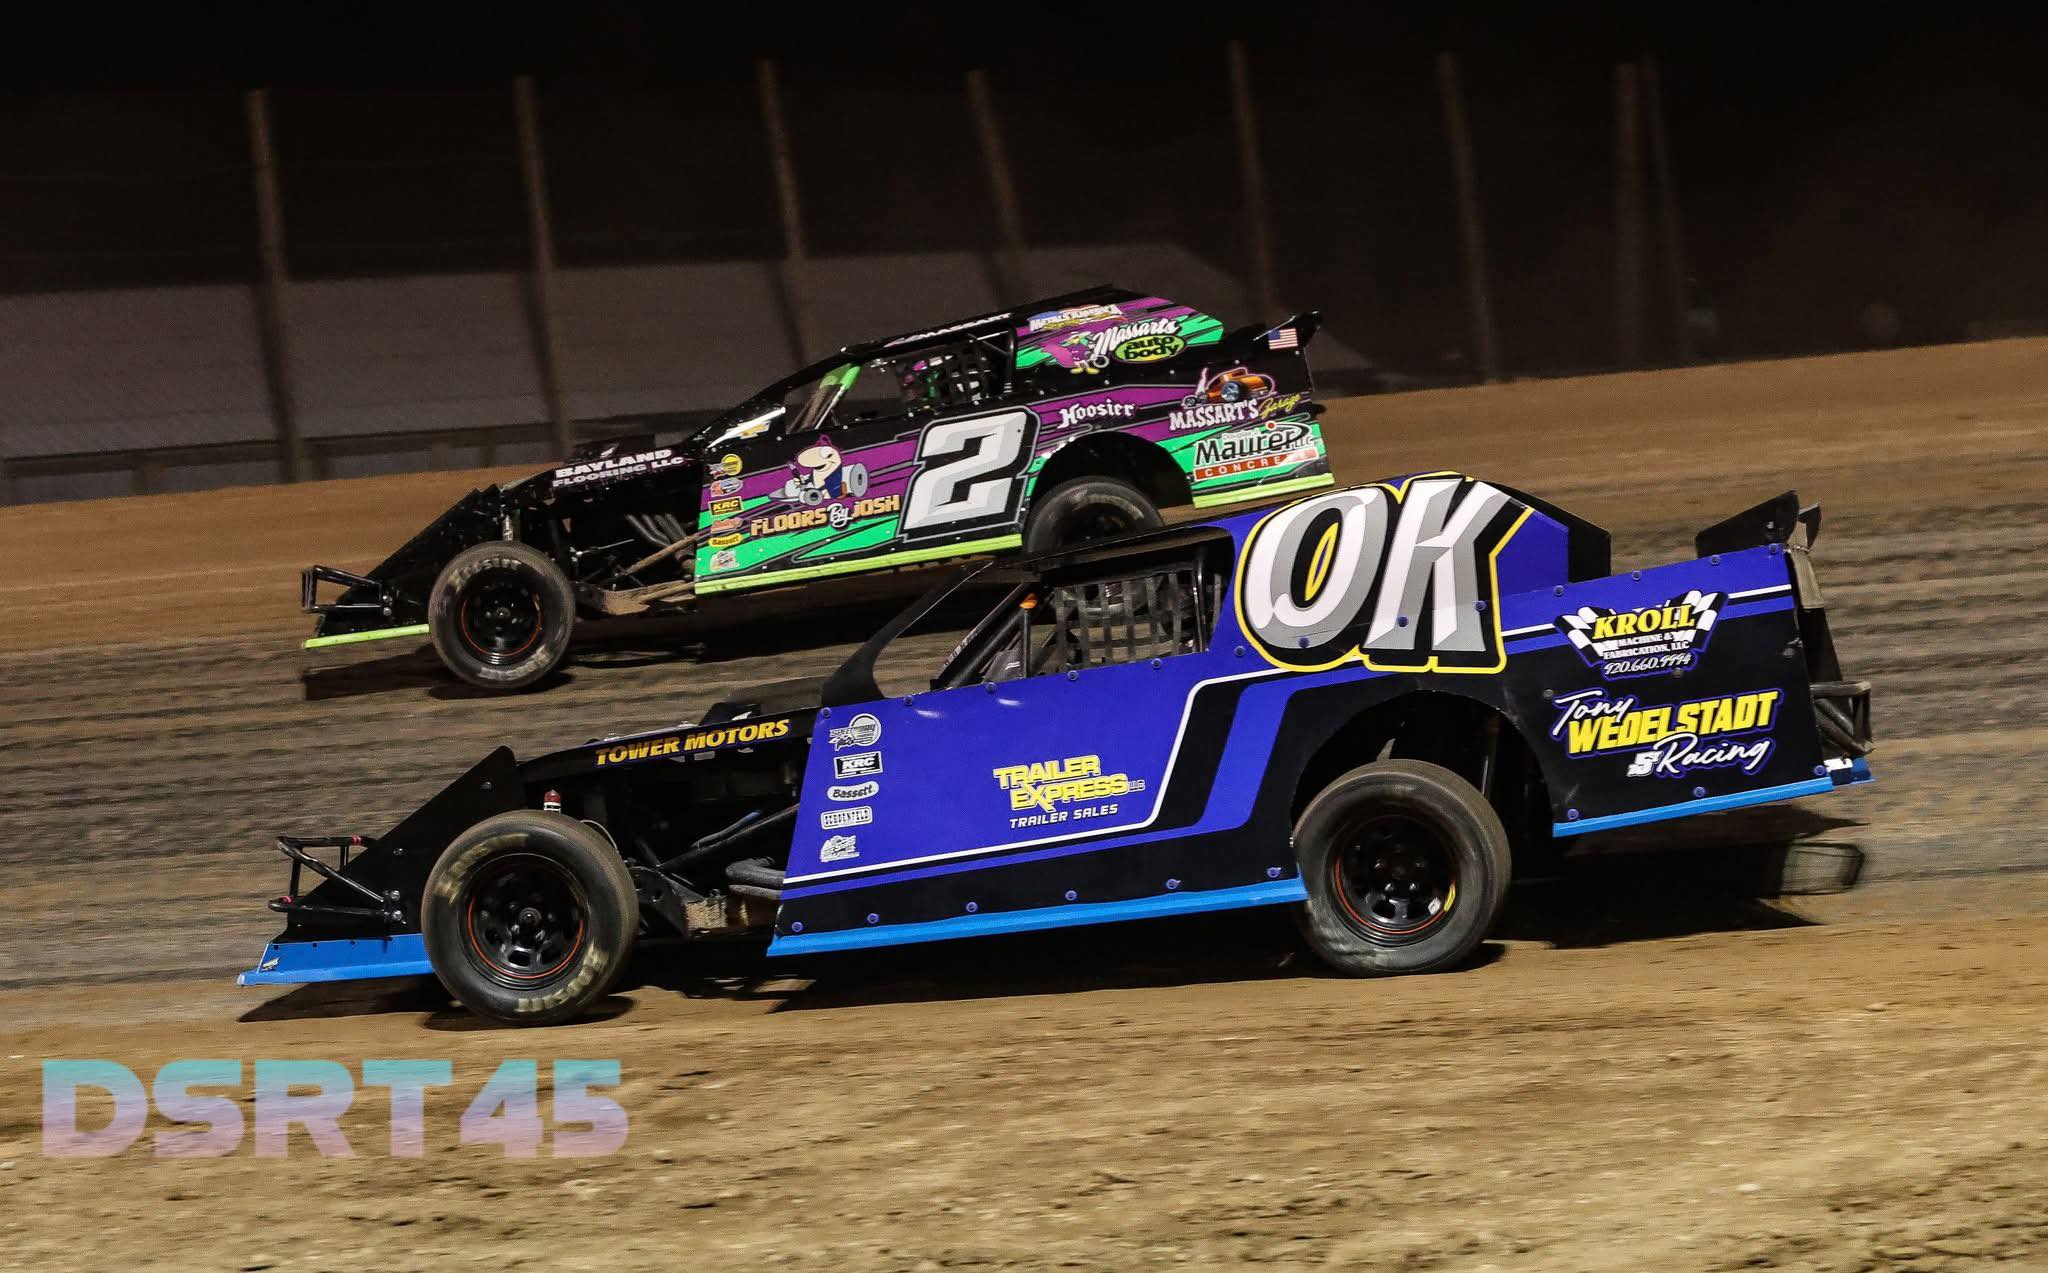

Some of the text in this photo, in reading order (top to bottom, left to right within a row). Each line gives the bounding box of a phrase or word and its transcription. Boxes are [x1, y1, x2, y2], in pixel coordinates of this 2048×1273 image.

[1125, 343, 1179, 360] body
[1126, 335, 1175, 350] auto
[1057, 398, 1136, 429] Hoosier
[1169, 399, 1259, 430] MASSART'S
[1195, 429, 1297, 465] Maurer
[552, 456, 685, 487] FLOORING LLC
[555, 449, 672, 478] BAYLAND
[900, 409, 1034, 535] 2
[1205, 451, 1304, 477] CONCRE
[751, 507, 828, 535] FLOORS
[827, 503, 853, 528] By
[852, 494, 900, 518] JOSH
[1592, 603, 1696, 640] KROLL
[1671, 641, 1691, 653] LLC
[1552, 690, 1634, 736] Tony
[1569, 692, 1779, 754] WEDELSTADT
[595, 719, 791, 766] TOWER MOTORS
[1654, 734, 1771, 775] Racing
[993, 755, 1101, 789] TRAILER
[833, 784, 873, 798] Bassett
[1011, 773, 1129, 813] EXPRESS
[1010, 804, 1119, 829] TRAILER SALES
